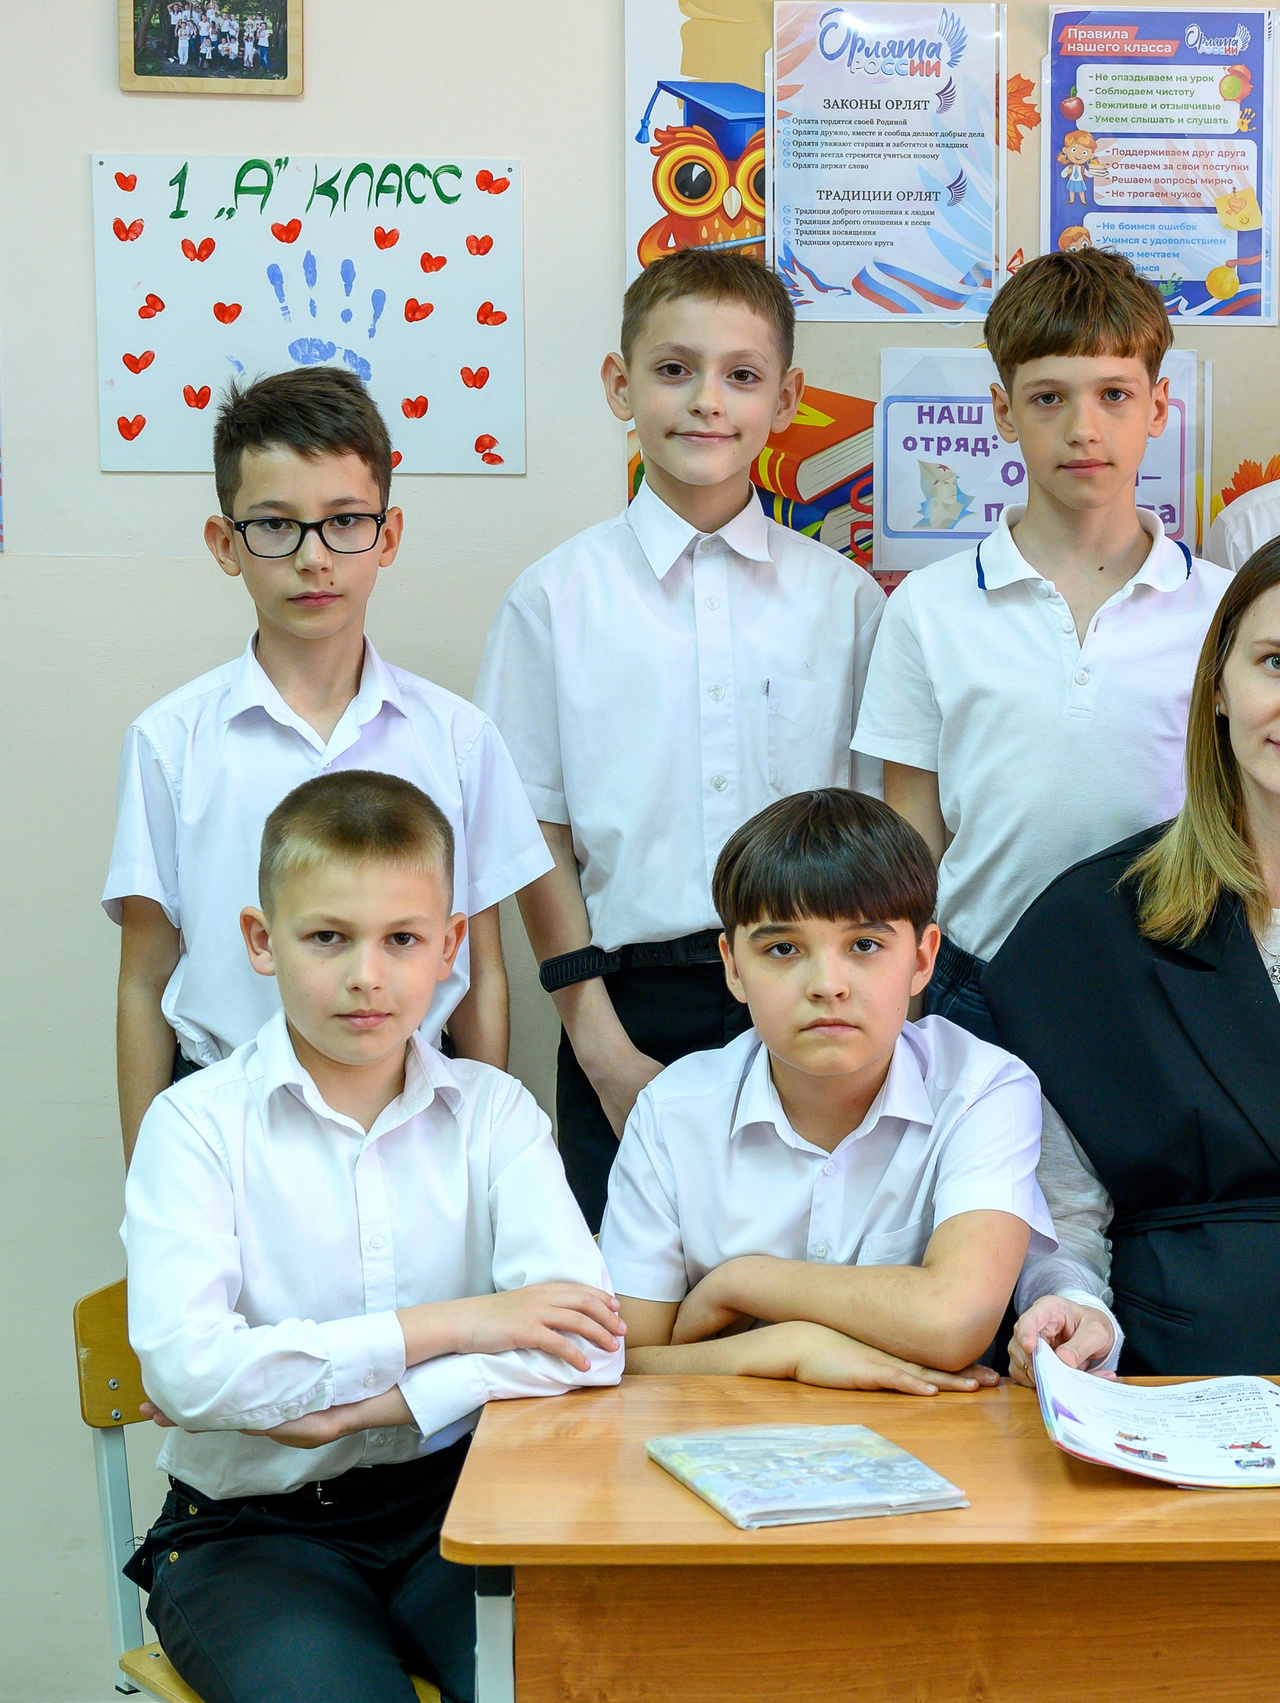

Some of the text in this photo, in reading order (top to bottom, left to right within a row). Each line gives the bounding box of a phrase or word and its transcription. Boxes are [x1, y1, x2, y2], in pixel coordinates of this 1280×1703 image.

[819, 7, 942, 67] Орлята
[1068, 26, 1128, 41] Правила
[1186, 24, 1239, 50] Орлята
[1067, 43, 1171, 52] нашего класса
[1095, 73, 1108, 81] Не
[1110, 74, 1172, 82] опаздываем
[1190, 75, 1214, 83] урок
[1094, 86, 1194, 97] Соблюдаем чистоту
[823, 98, 929, 110] ЗАКОНЫ ОРЛЯТ
[1095, 101, 1148, 109] Вежливые
[1094, 115, 1127, 123] Умеем
[1186, 117, 1228, 125] слушать
[792, 128, 818, 136] Орлята
[883, 129, 910, 137] сообща
[939, 130, 966, 138] добрые
[792, 139, 818, 148] Орлята
[792, 150, 818, 159] Орлята
[1112, 148, 1245, 158] Поддерживаем друг друга
[792, 161, 818, 170] Орлята
[1111, 161, 1160, 170] Отвечаем
[1202, 164, 1248, 172] поступки
[1111, 175, 1151, 183] Решаем
[1154, 178, 1197, 186] вопросы
[168, 162, 189, 219] 1
[305, 162, 463, 218] КЛАСС
[1111, 189, 1201, 200] Не трогаем чужое
[816, 190, 940, 202] ТРАДИЦИИ ОРЛЯТ
[794, 208, 830, 216] Традиция
[794, 218, 830, 226] Традиция
[831, 219, 861, 227] доброго
[1118, 221, 1155, 230] боимся
[1157, 222, 1197, 230] ошибок
[794, 228, 830, 236] Традиция
[794, 238, 830, 246] Традиция
[1102, 236, 1139, 244] Учимся
[1149, 237, 1226, 246] удовольствием
[917, 405, 983, 425] НАШ
[903, 435, 999, 457] отряд:
